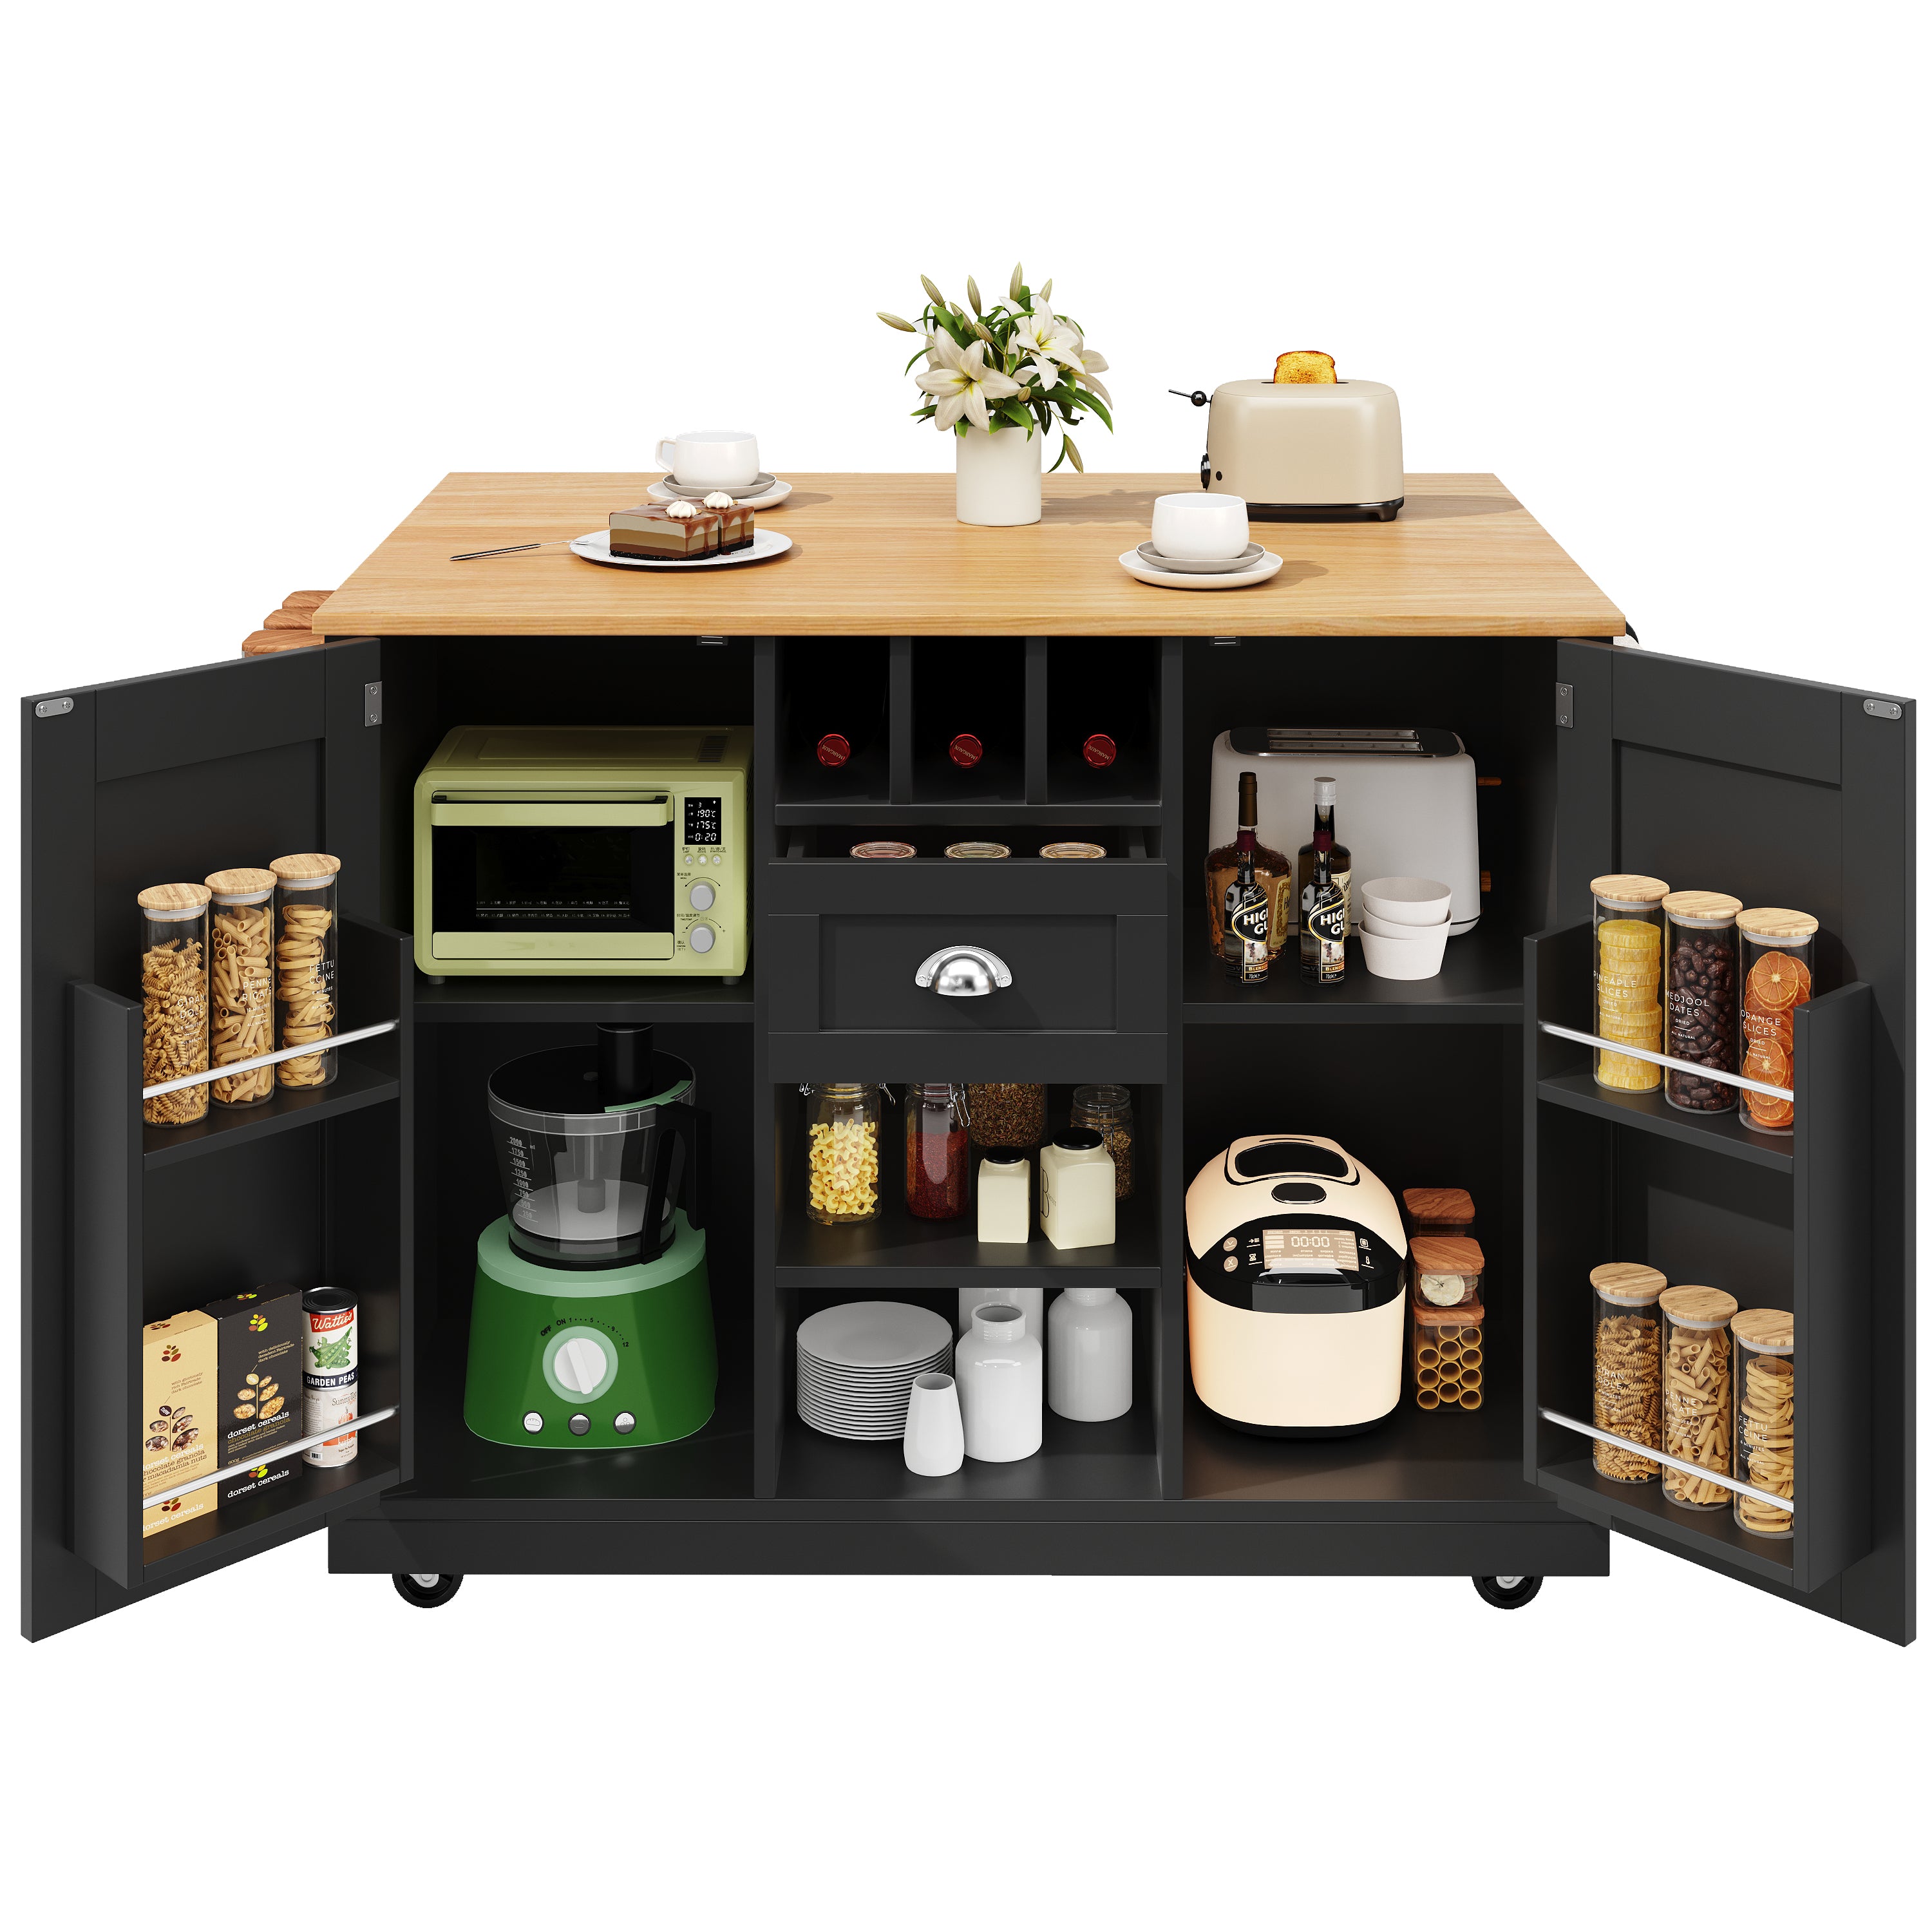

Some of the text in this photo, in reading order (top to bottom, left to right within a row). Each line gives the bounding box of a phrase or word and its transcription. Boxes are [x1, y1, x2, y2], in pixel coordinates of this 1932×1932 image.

[822, 744, 844, 760] MARGAUX
[954, 744, 976, 760] MARGAUX
[1088, 745, 1110, 760] MARGAUX
[310, 960, 334, 972] FETTU
[243, 975, 271, 989] PENNE
[309, 971, 334, 984] CCINE
[1593, 970, 1637, 988] PINEAPLE
[317, 986, 333, 994] MINUTES
[1597, 983, 1628, 998] SLICES
[178, 994, 205, 1007] GIRAN
[180, 1005, 204, 1019] DOLE
[1669, 1002, 1700, 1016] DATES
[1741, 1010, 1781, 1025] ORANGE
[1743, 1021, 1776, 1036] SLICES
[510, 1137, 522, 1146] 2000
[512, 1148, 524, 1157] 1750
[513, 1158, 526, 1167] 1500
[515, 1168, 527, 1177] 1250
[516, 1179, 529, 1188] 1000
[519, 1189, 529, 1198] 750
[1291, 1236, 1330, 1247] 00:00
[312, 1311, 352, 1329] Wattie's
[540, 1325, 551, 1336] OFF
[307, 1372, 354, 1386] GARDEN PEAS
[1597, 1365, 1624, 1379] GIRAN
[1598, 1376, 1622, 1390] DOLE
[1665, 1388, 1696, 1405] PENNE
[1665, 1399, 1698, 1416] RIGATE
[228, 1423, 256, 1439] dorset
[258, 1412, 289, 1427] cereals
[228, 1428, 261, 1444] chocolate
[263, 1417, 291, 1432] granola
[1739, 1416, 1767, 1431] FETTU
[1739, 1426, 1767, 1441] CCINE
[171, 1444, 204, 1460] cereals
[1744, 1443, 1765, 1452] MINUTES
[143, 1450, 205, 1476] hocolate granola
[147, 1462, 189, 1481] macadamia
[191, 1454, 207, 1464] nuts
[228, 1470, 289, 1498] dorset cereals
[171, 1503, 204, 1520] cereals
